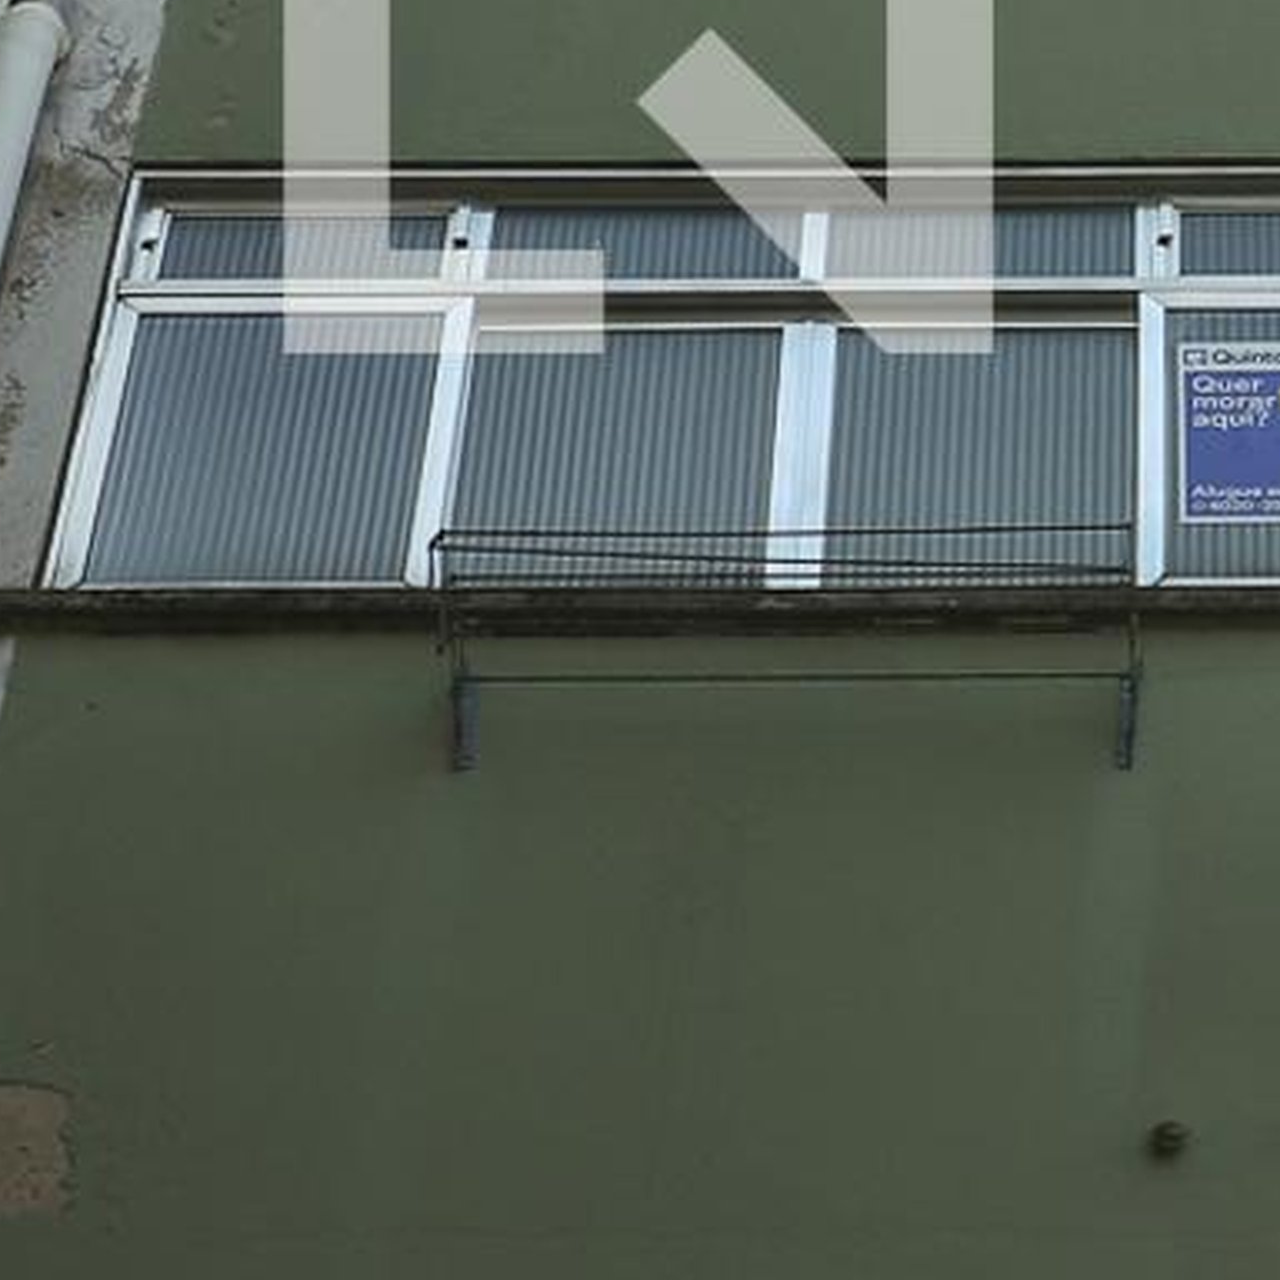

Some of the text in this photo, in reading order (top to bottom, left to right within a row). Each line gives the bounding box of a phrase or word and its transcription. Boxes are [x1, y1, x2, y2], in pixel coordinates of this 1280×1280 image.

[1192, 375, 1265, 394] Quer
[1192, 396, 1277, 411] morar
[1192, 411, 1270, 431] aqui?
